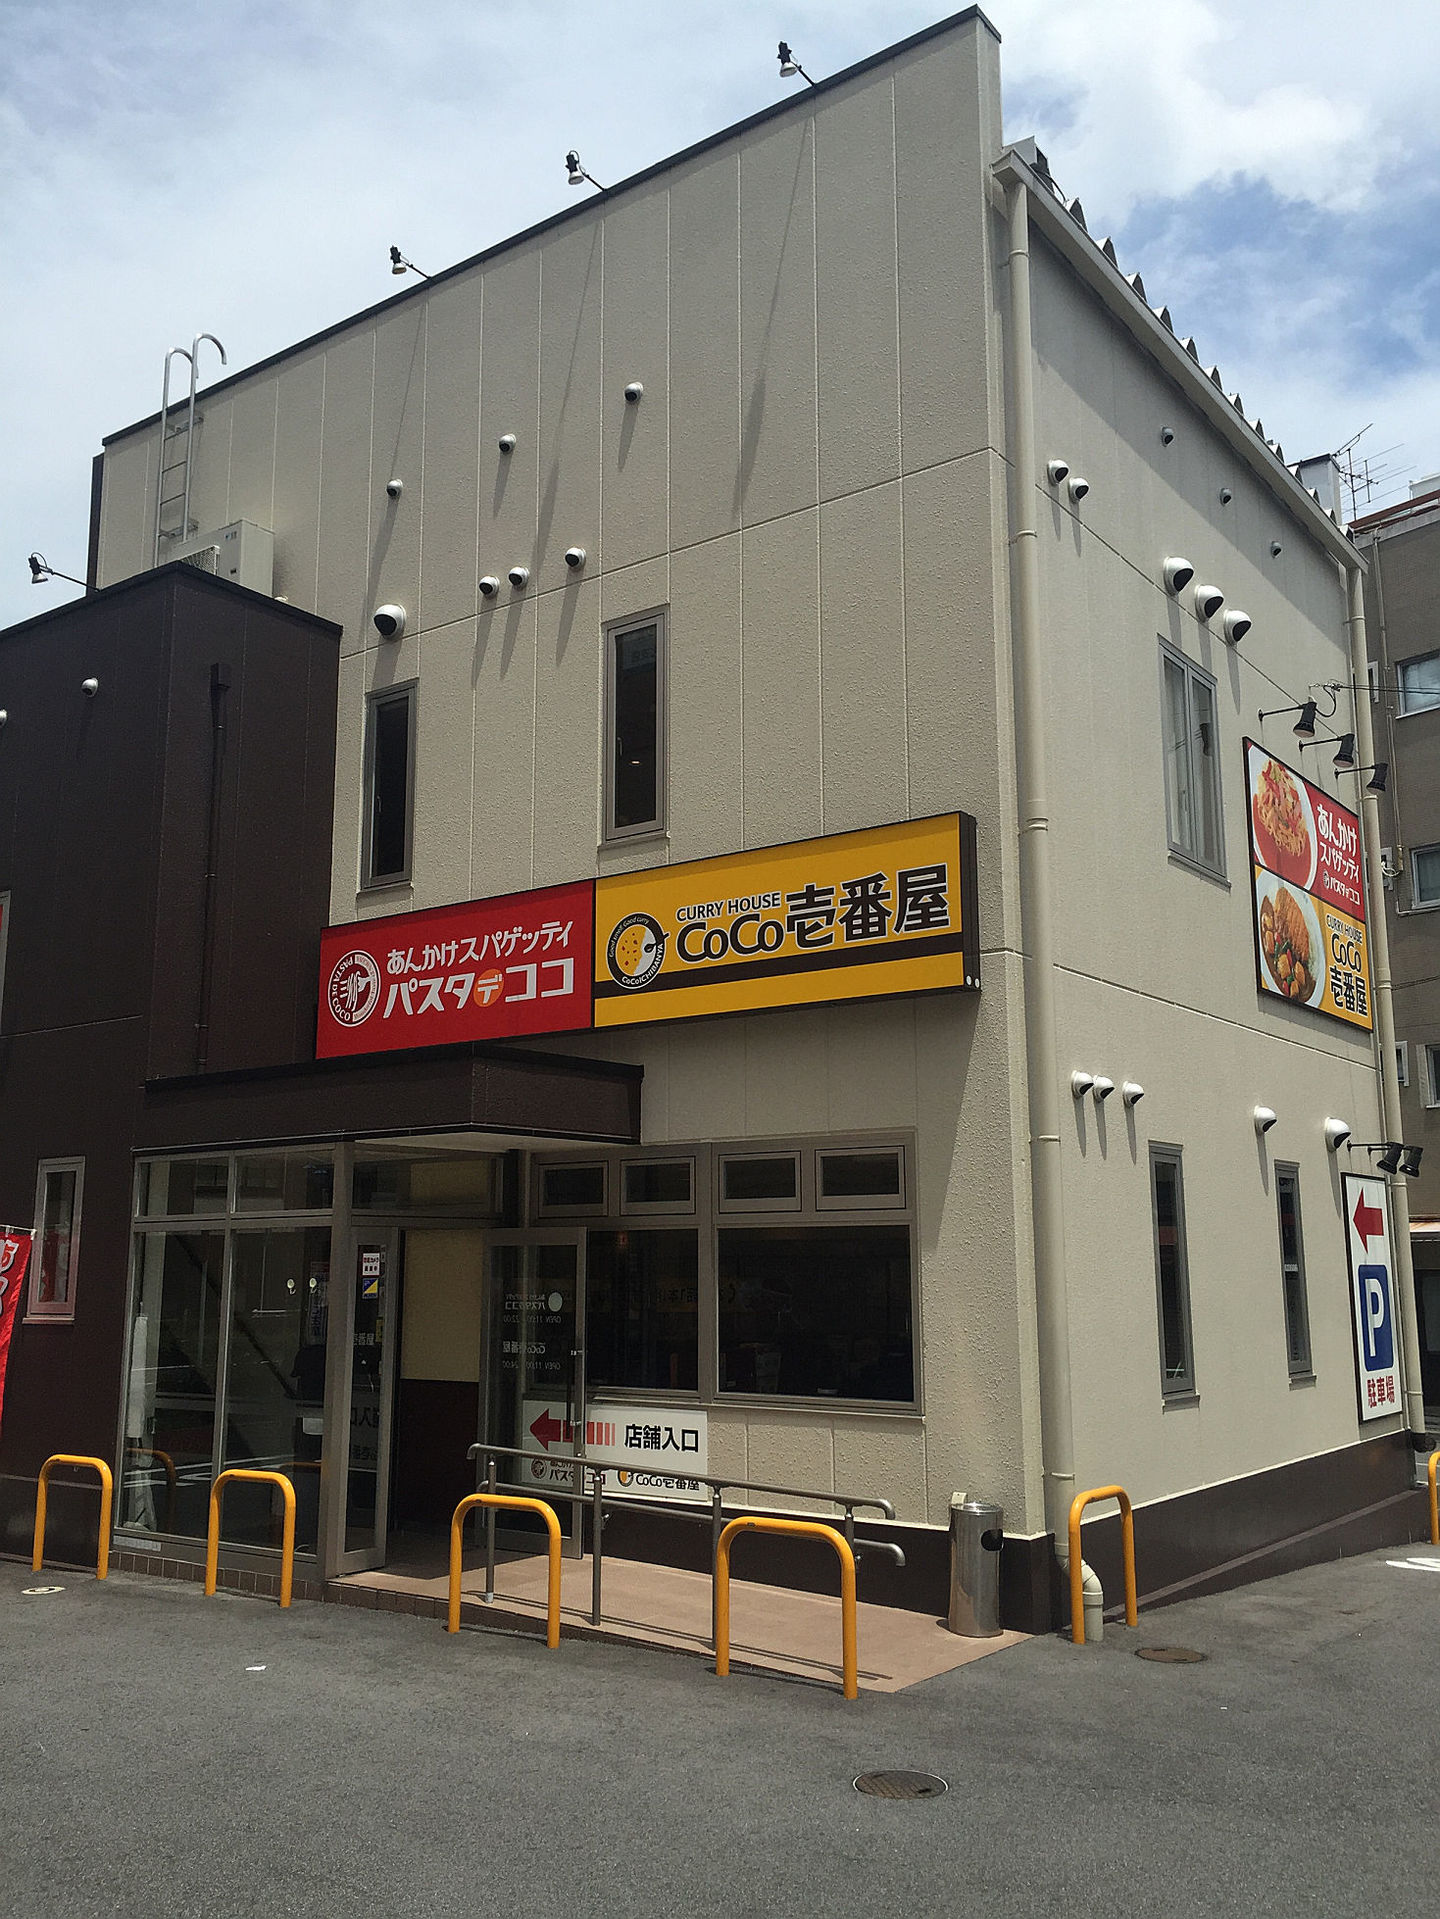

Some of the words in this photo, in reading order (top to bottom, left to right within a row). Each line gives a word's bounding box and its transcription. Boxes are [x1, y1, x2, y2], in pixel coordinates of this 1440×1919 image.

[1317, 803, 1357, 853] あんかけ
[1319, 842, 1360, 885] スパゲッティ
[676, 901, 724, 922] CURRY
[727, 891, 781, 915] HOUSE
[676, 863, 951, 964] CoCo壱番屋
[386, 921, 574, 975] あんかけスパゲッティ
[1326, 914, 1345, 937] CURRY
[1345, 922, 1363, 944] HOUSE
[332, 956, 353, 982] PASTA
[1331, 933, 1362, 973] CoCo
[382, 957, 574, 1019] パスタデココ
[1330, 965, 1368, 1017] 壱番屋
[332, 997, 351, 1021] COCO
[1364, 1278, 1384, 1357] P
[1367, 1375, 1395, 1409] 駐車場
[624, 1423, 699, 1453] 店舗入口
